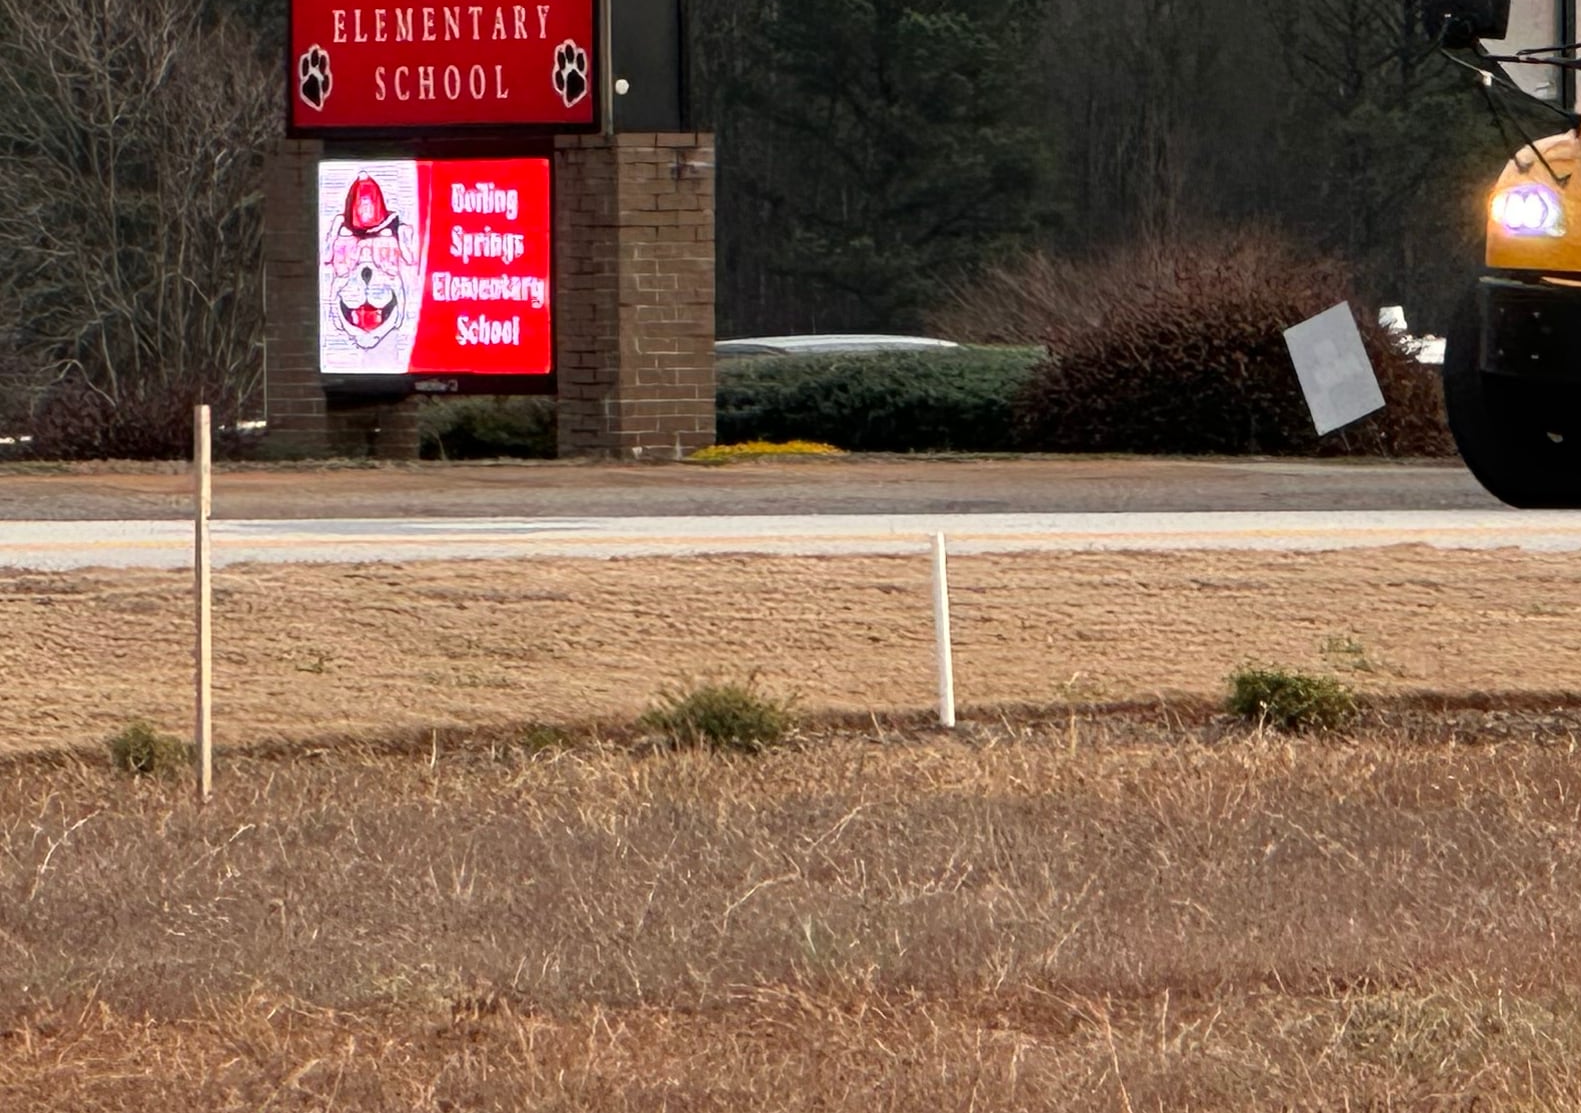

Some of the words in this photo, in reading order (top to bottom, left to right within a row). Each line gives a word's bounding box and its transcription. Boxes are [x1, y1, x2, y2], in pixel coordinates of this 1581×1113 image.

[333, 5, 550, 43] ELEMENTARY
[375, 64, 508, 101] SCHOOL
[451, 182, 519, 220] Boiling
[450, 225, 525, 265] Springs
[431, 271, 545, 309] Elementary
[455, 314, 520, 346] School
